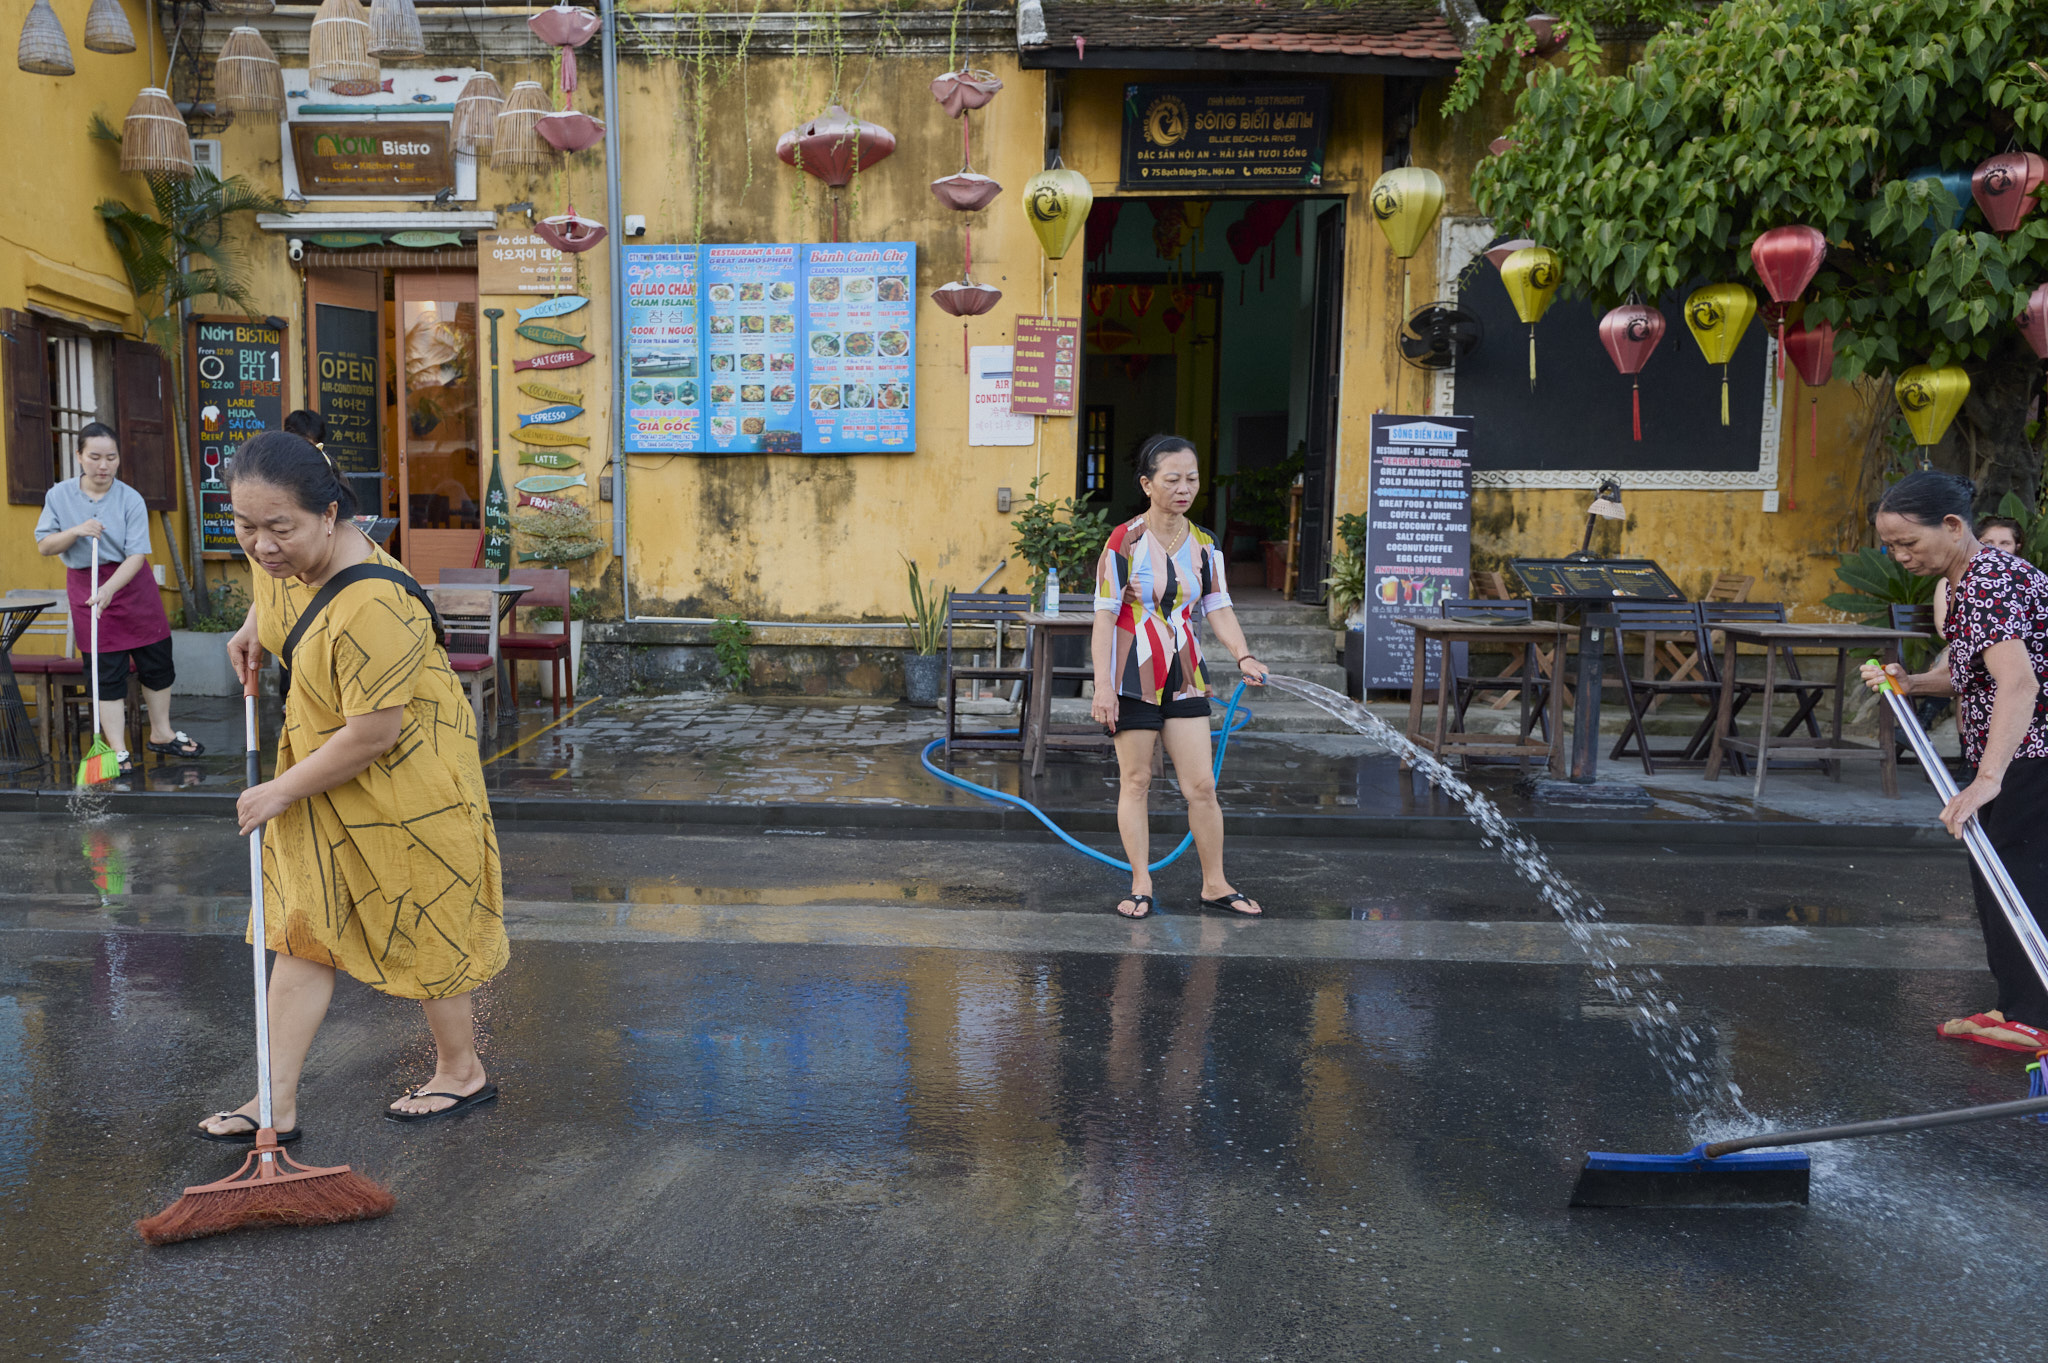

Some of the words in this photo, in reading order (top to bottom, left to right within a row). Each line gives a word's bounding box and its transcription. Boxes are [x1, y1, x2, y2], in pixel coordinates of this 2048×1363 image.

[1254, 95, 1305, 105] RESTAURANT
[1194, 110, 1237, 130] SÔNG
[1273, 111, 1314, 130] XANH
[1232, 135, 1262, 143] BEACH
[1263, 135, 1270, 143] &
[1271, 134, 1297, 143] RIVER
[382, 140, 430, 155] Bistro
[1151, 168, 1161, 176] 75
[1225, 168, 1236, 176] An
[1253, 166, 1302, 176] 0905.762.567
[496, 235, 510, 245] Ao
[512, 235, 527, 245] dai
[492, 248, 537, 262] 아오자이
[710, 248, 764, 257] RESTAURANT
[765, 248, 772, 256] &
[847, 249, 880, 262] Canh
[536, 266, 549, 274] day
[645, 283, 665, 296] LAO
[631, 299, 659, 307] CHAM
[240, 349, 267, 365] BUY
[270, 350, 281, 382] 1
[531, 355, 550, 368] SALT
[550, 352, 575, 365] COFFEE
[240, 364, 267, 381] GET
[321, 358, 373, 383] OPEN
[200, 380, 210, 389] To
[240, 380, 281, 397] FREE
[321, 382, 374, 396] AIR-CONDITIONER
[995, 380, 1010, 389] AIR
[227, 398, 256, 408] LARUE
[975, 393, 1012, 404] CONDITI
[227, 408, 256, 418] HUDA
[530, 411, 567, 424] ESPRESSO
[327, 413, 371, 427] エアコン
[638, 420, 660, 431] GIÁ
[331, 429, 368, 443] 冷气机
[1392, 426, 1413, 440] SÔNG
[1433, 430, 1454, 440] XANH
[1376, 446, 1411, 455] RESTAURANT
[1413, 448, 1426, 456] BAR
[1428, 448, 1449, 457] COFFEE
[1452, 449, 1469, 457] JUICE
[535, 454, 558, 465] LATTE
[1382, 456, 1420, 466] TERRACE
[1421, 457, 1462, 468] UPSTAIRS
[1380, 467, 1407, 476] GREAT
[1407, 468, 1464, 478] ATMOSPHERE
[1379, 477, 1401, 486] COLD
[1402, 478, 1441, 487] DRAUGHT
[1441, 479, 1464, 488] BEER
[1378, 499, 1403, 508] GREAT
[1404, 500, 1425, 509] FOOD
[1426, 501, 1432, 509] &
[1433, 502, 1464, 510] DRINKS
[1390, 511, 1420, 519] COFFEE
[1420, 512, 1427, 520] &
[1428, 512, 1452, 520] JUICE
[1372, 521, 1399, 530] FRESH
[1399, 521, 1436, 531] COCONUT
[1436, 523, 1444, 531] &
[1444, 523, 1468, 532] JUICE
[1395, 532, 1415, 541] SALT
[1415, 533, 1445, 542] COFFEE
[486, 548, 501, 557] THE
[1386, 543, 1423, 552] COCONUT
[1423, 544, 1454, 553] COFFEE
[1396, 554, 1413, 563] EGG
[1413, 555, 1443, 564] COFFEE
[1374, 565, 1414, 574] ANYTHING
[1414, 566, 1424, 575] IS
[1424, 566, 1465, 576] POSSIBLE
